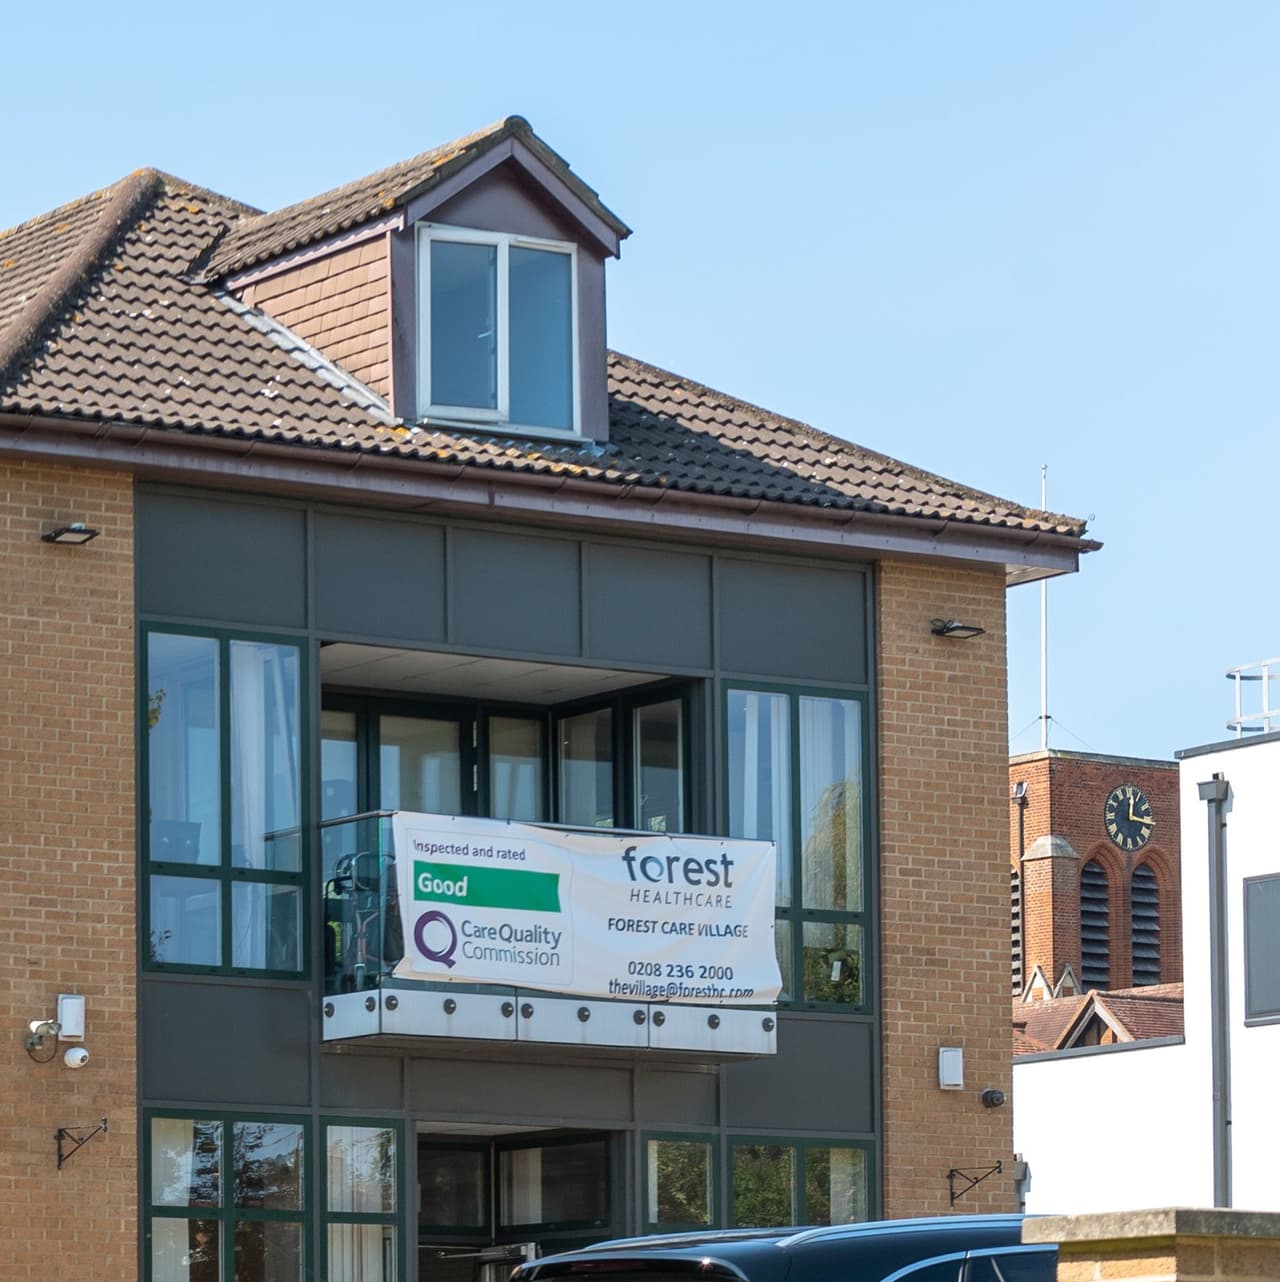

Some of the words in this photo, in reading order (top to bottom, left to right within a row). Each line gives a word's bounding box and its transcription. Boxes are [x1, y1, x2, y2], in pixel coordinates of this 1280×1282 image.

[413, 839, 469, 856] Inspected
[472, 846, 494, 858] and
[496, 848, 526, 861] rated
[622, 846, 734, 888] forest
[417, 872, 469, 897] Good
[630, 888, 733, 909] HEALTHCARE
[608, 917, 659, 934] FOREST
[660, 921, 695, 936] CARE
[697, 923, 749, 938] VILLAGE
[461, 940, 561, 967] Commission
[627, 960, 663, 977] 0208
[666, 964, 694, 979] 236
[698, 965, 734, 981] 2000
